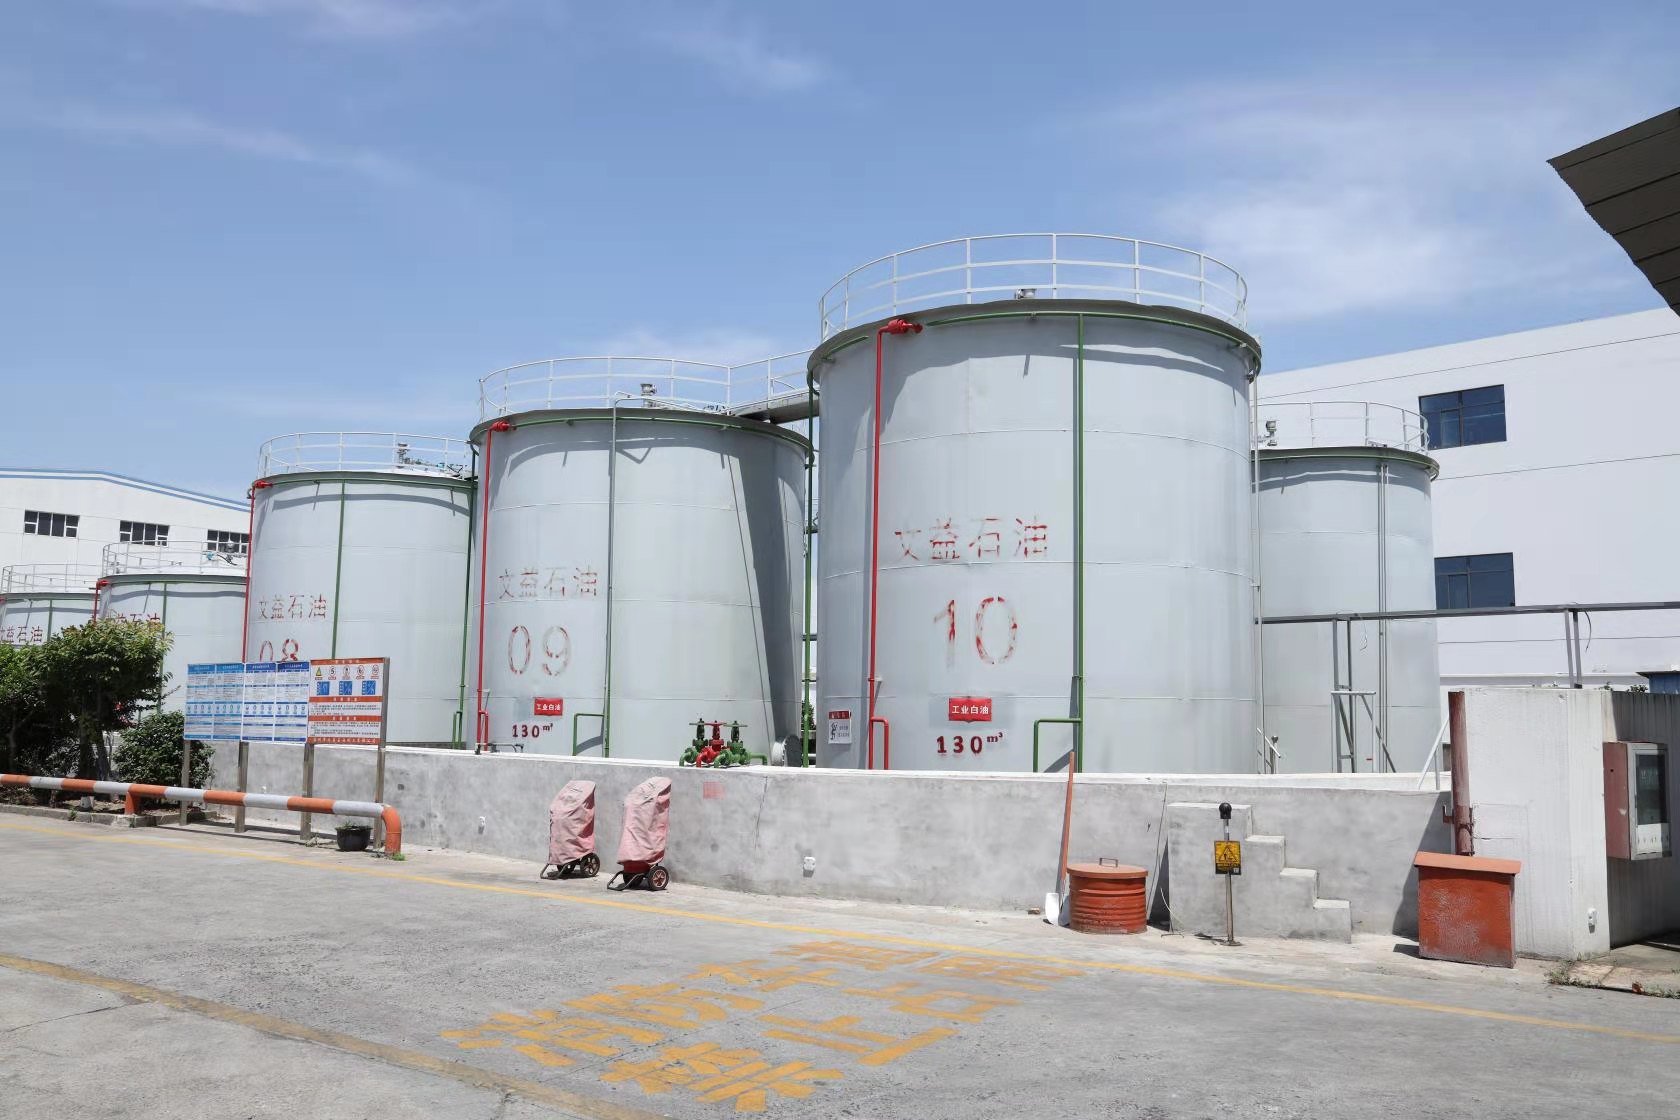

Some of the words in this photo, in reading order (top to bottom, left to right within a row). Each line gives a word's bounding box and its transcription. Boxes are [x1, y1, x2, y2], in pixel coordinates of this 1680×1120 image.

[508, 625, 571, 676] 09
[933, 596, 1018, 670] 10
[536, 703, 561, 711] 工业白油
[951, 704, 990, 715] 工业白油
[601, 955, 1087, 1113] 禁止占用
